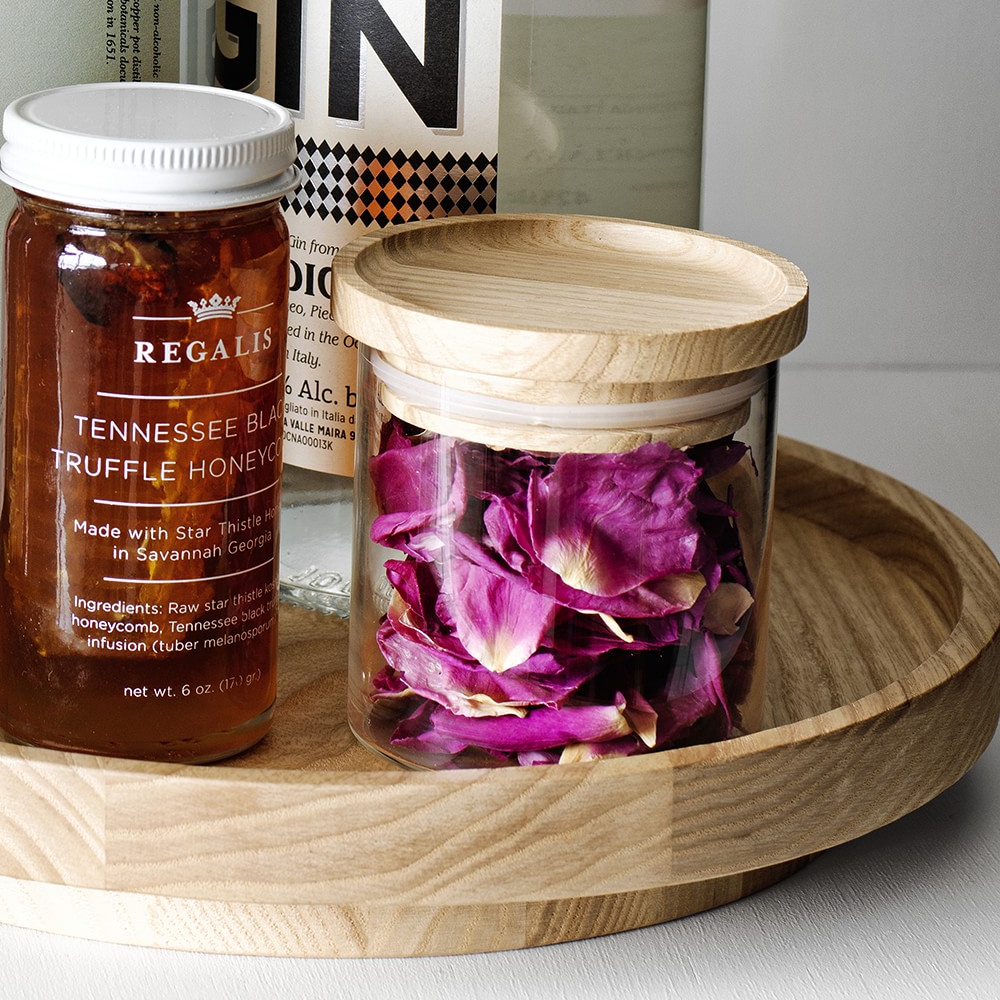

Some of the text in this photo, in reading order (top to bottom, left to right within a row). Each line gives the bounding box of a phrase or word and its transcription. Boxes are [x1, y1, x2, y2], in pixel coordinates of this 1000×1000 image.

[107, 17, 116, 28] in
[120, 0, 129, 53] botanicals
[106, 33, 116, 65] 1651.
[130, 36, 140, 53] pot
[153, 4, 161, 78] non-alcoholic
[309, 240, 340, 256] from
[133, 327, 273, 364] REGALIS
[304, 327, 315, 341] in
[319, 331, 339, 345] the
[293, 349, 321, 369] Italy.
[298, 379, 338, 405] Alc.
[311, 407, 319, 418] in
[322, 410, 345, 423] Italia
[73, 414, 238, 443] TENNESSEE
[290, 418, 314, 433] VALLE
[318, 425, 346, 440] MAIRA
[51, 448, 177, 482] TRUFFLE
[73, 519, 121, 539] Made
[128, 527, 168, 541] with
[176, 525, 211, 540] Star
[218, 514, 262, 536] Thistle
[112, 529, 272, 562] in Savannah Georgia
[74, 595, 163, 615] Ingredients:
[168, 602, 199, 614] Raw
[204, 599, 229, 613] star
[233, 587, 263, 607] thistle
[71, 614, 163, 634] honeycomb,
[169, 615, 238, 633] Tennessee
[241, 603, 265, 623] black
[87, 635, 147, 652] infusion
[152, 639, 199, 654] (tuber
[124, 686, 148, 698] net
[154, 684, 176, 698] wt.
[182, 684, 191, 696] 6
[195, 682, 215, 696] oz.
